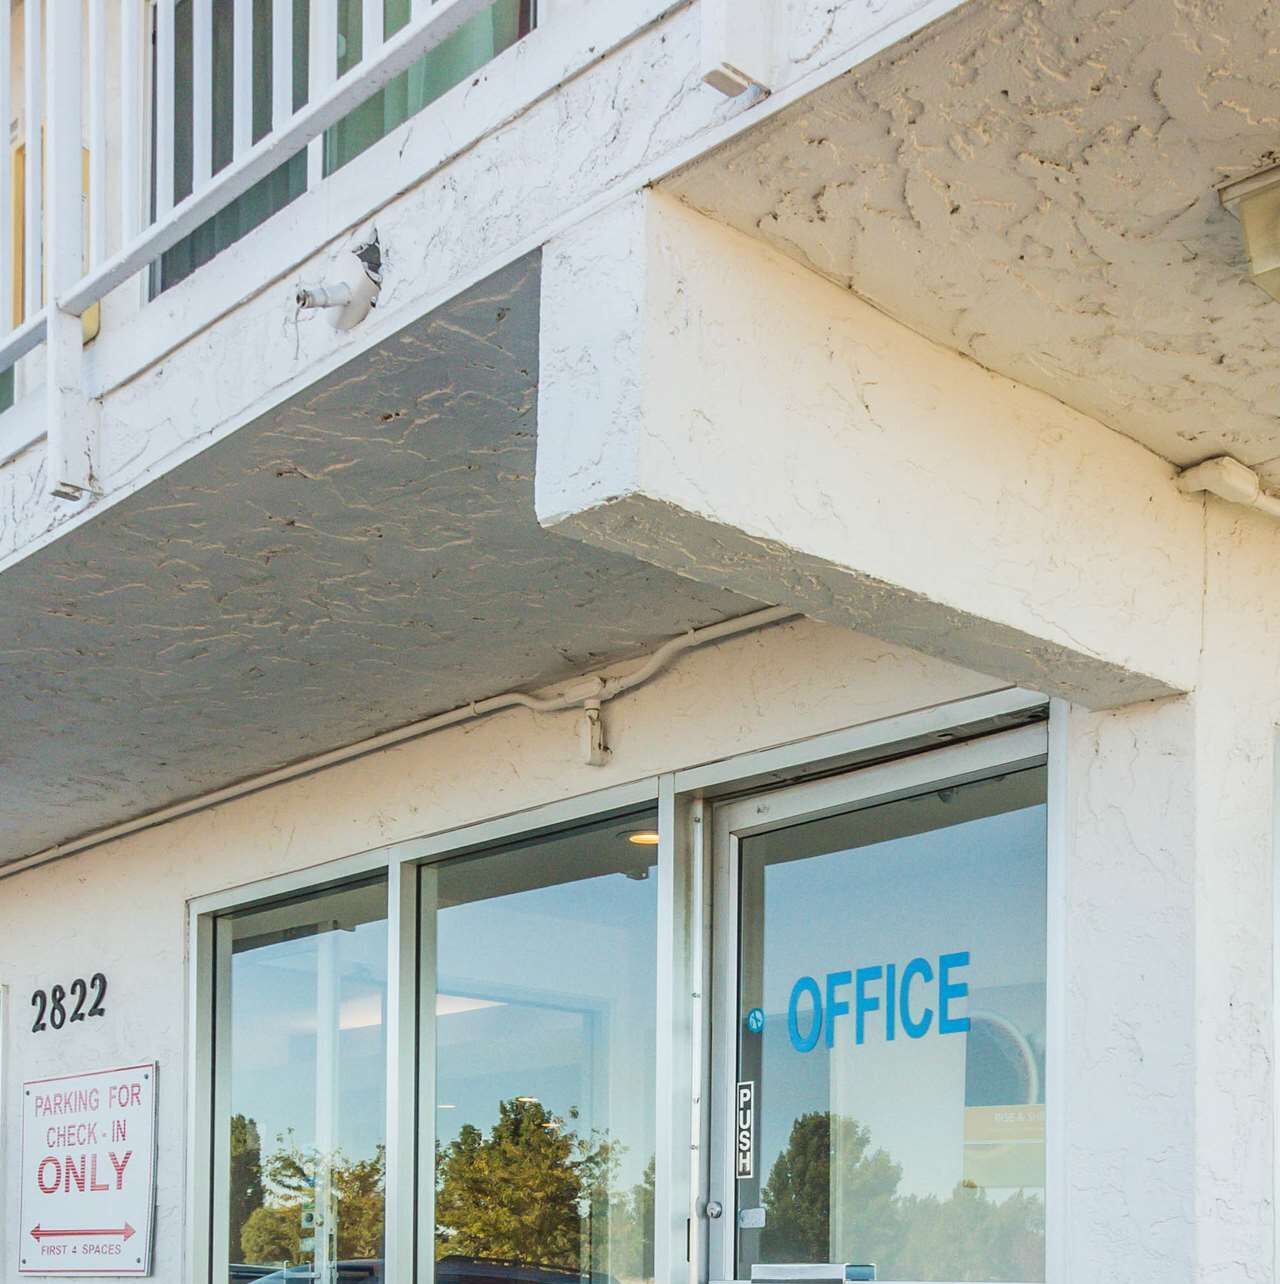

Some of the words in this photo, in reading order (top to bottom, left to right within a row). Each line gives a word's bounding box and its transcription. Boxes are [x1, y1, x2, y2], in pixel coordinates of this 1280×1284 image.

[31, 972, 108, 1033] 2822
[788, 951, 970, 1053] OFFICE
[35, 1088, 100, 1117] PARKING
[109, 1083, 142, 1109] FOR
[739, 1088, 751, 1172] PUSH
[37, 1150, 133, 1194] ONLY
[41, 1244, 67, 1255] FIRST
[82, 1244, 122, 1255] SPACES
